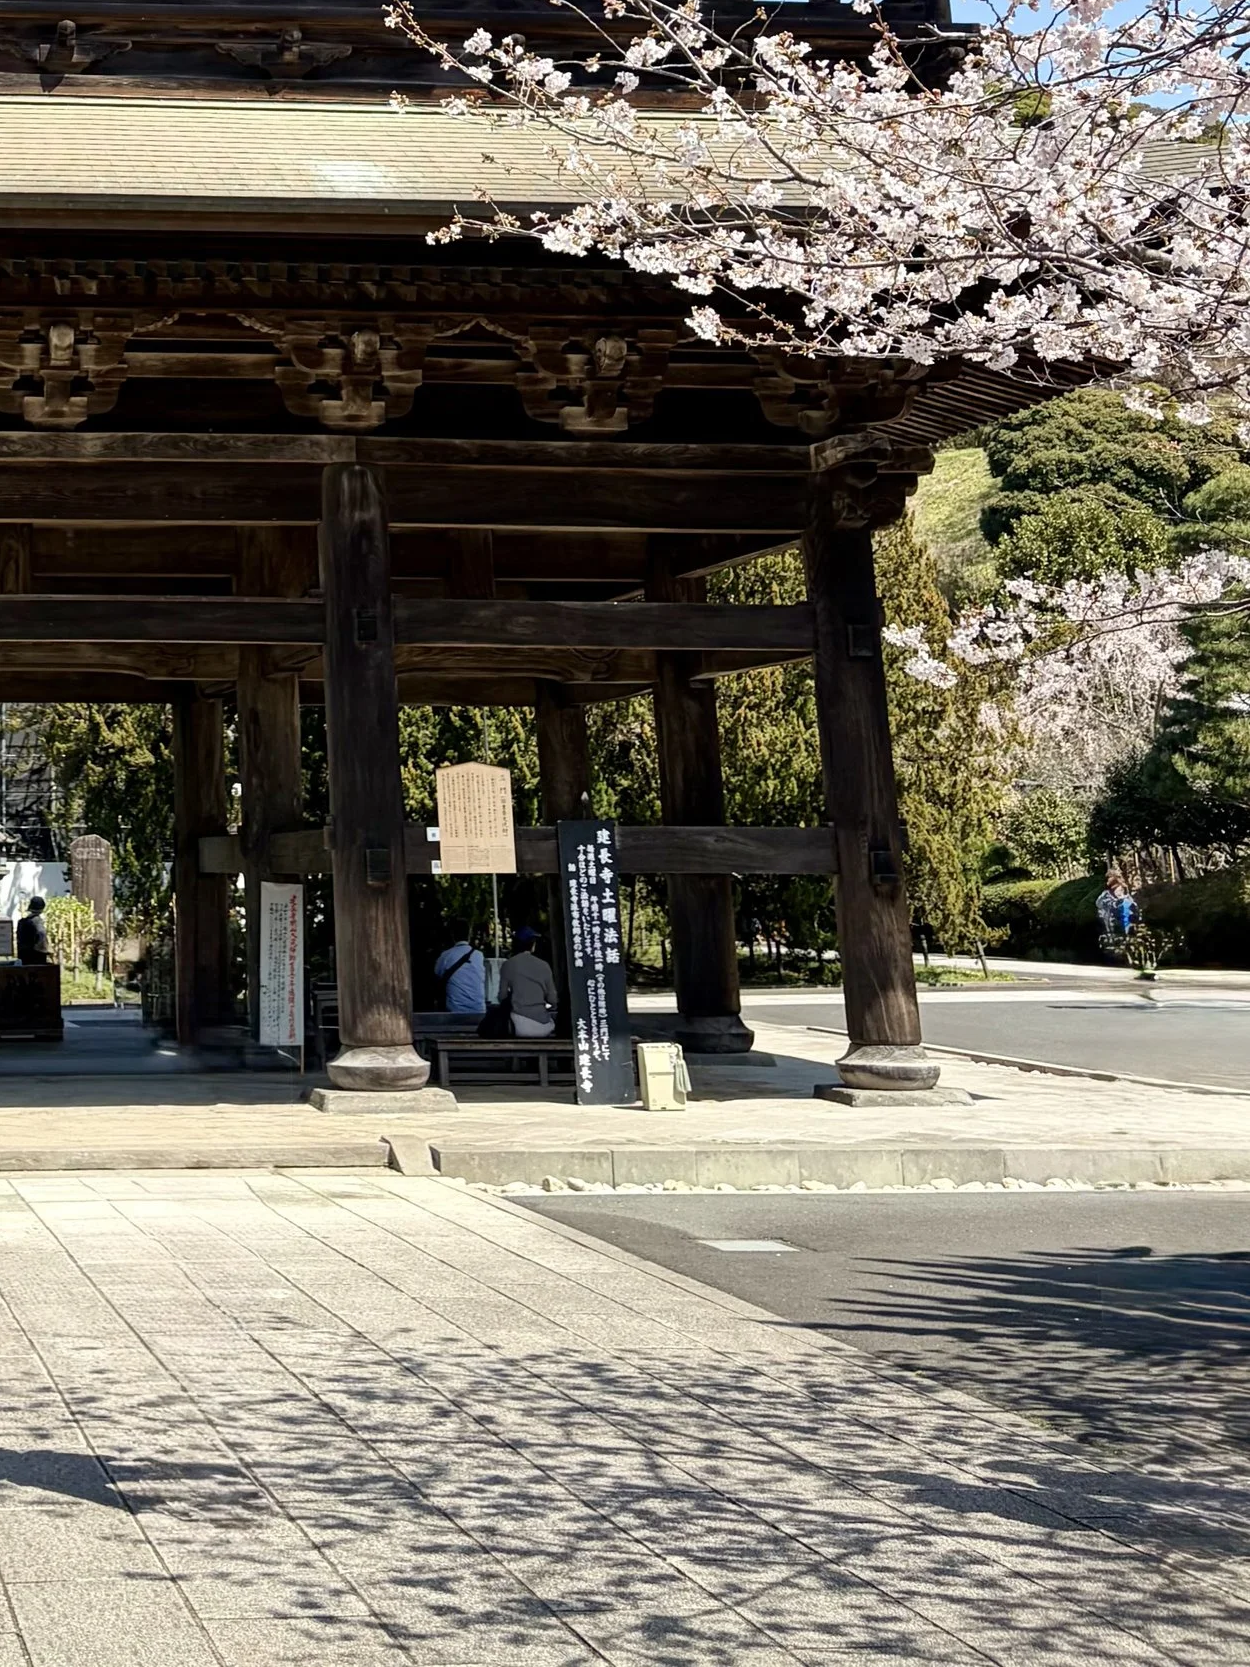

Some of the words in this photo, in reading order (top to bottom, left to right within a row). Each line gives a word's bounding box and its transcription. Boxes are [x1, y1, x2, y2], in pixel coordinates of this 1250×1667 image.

[596, 828, 621, 964] 建長寺土曜法話
